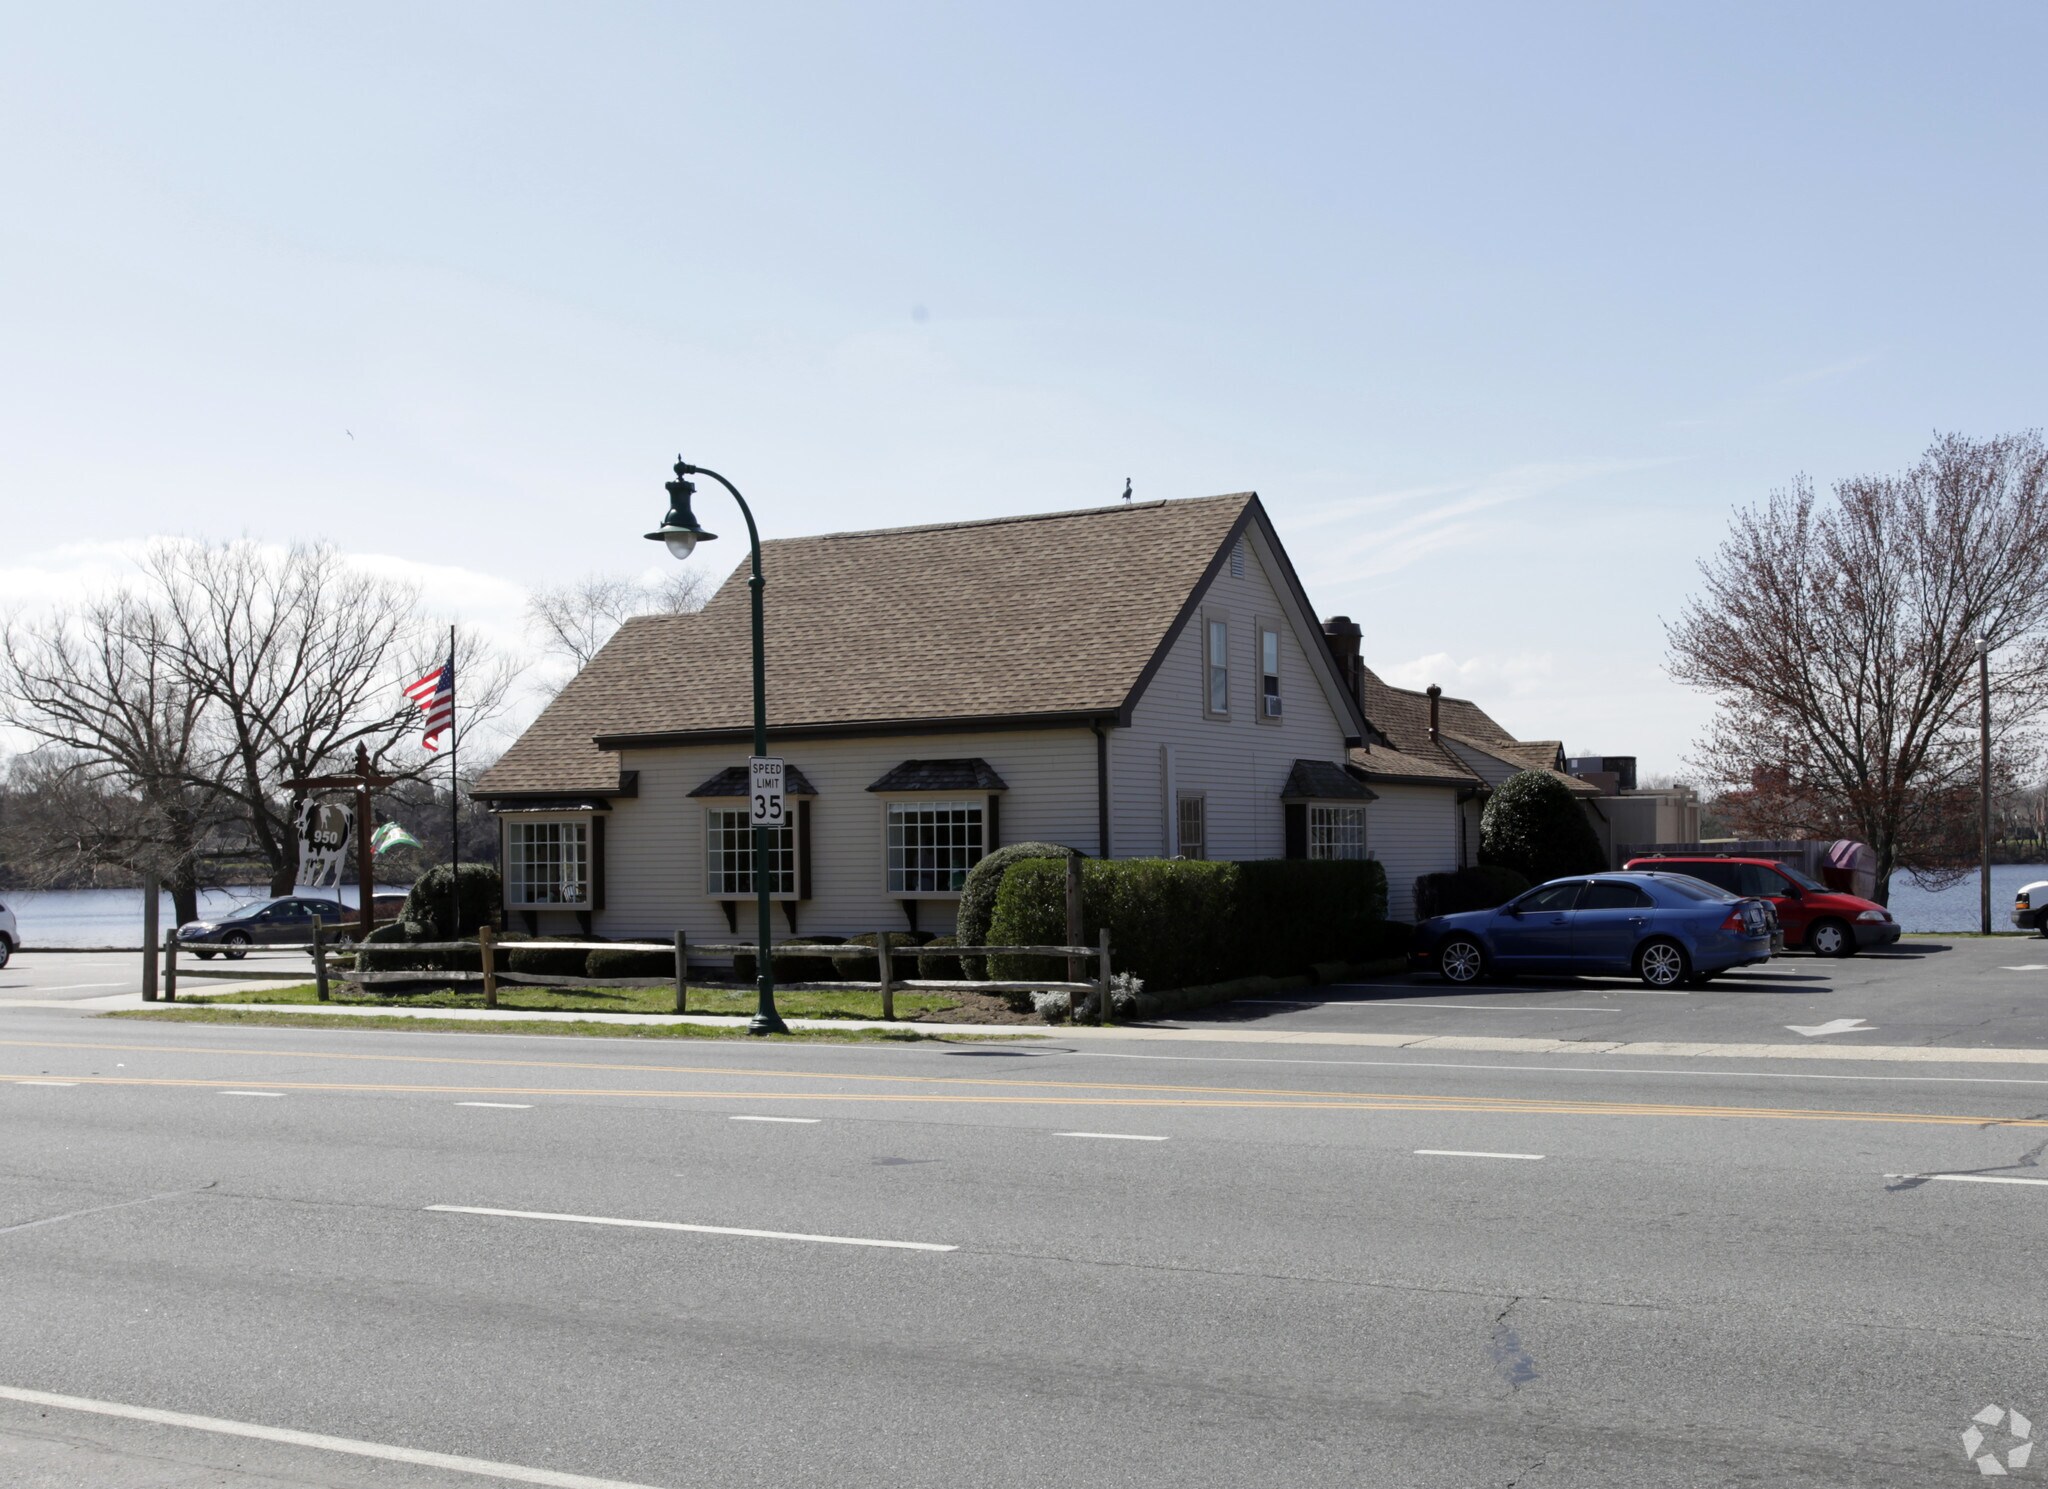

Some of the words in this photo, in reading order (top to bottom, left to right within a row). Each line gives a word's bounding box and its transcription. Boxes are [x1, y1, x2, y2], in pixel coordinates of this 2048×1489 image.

[753, 763, 782, 774] SPEED
[757, 778, 779, 788] LIMIT
[754, 794, 782, 819] 35
[314, 830, 338, 844] 950
